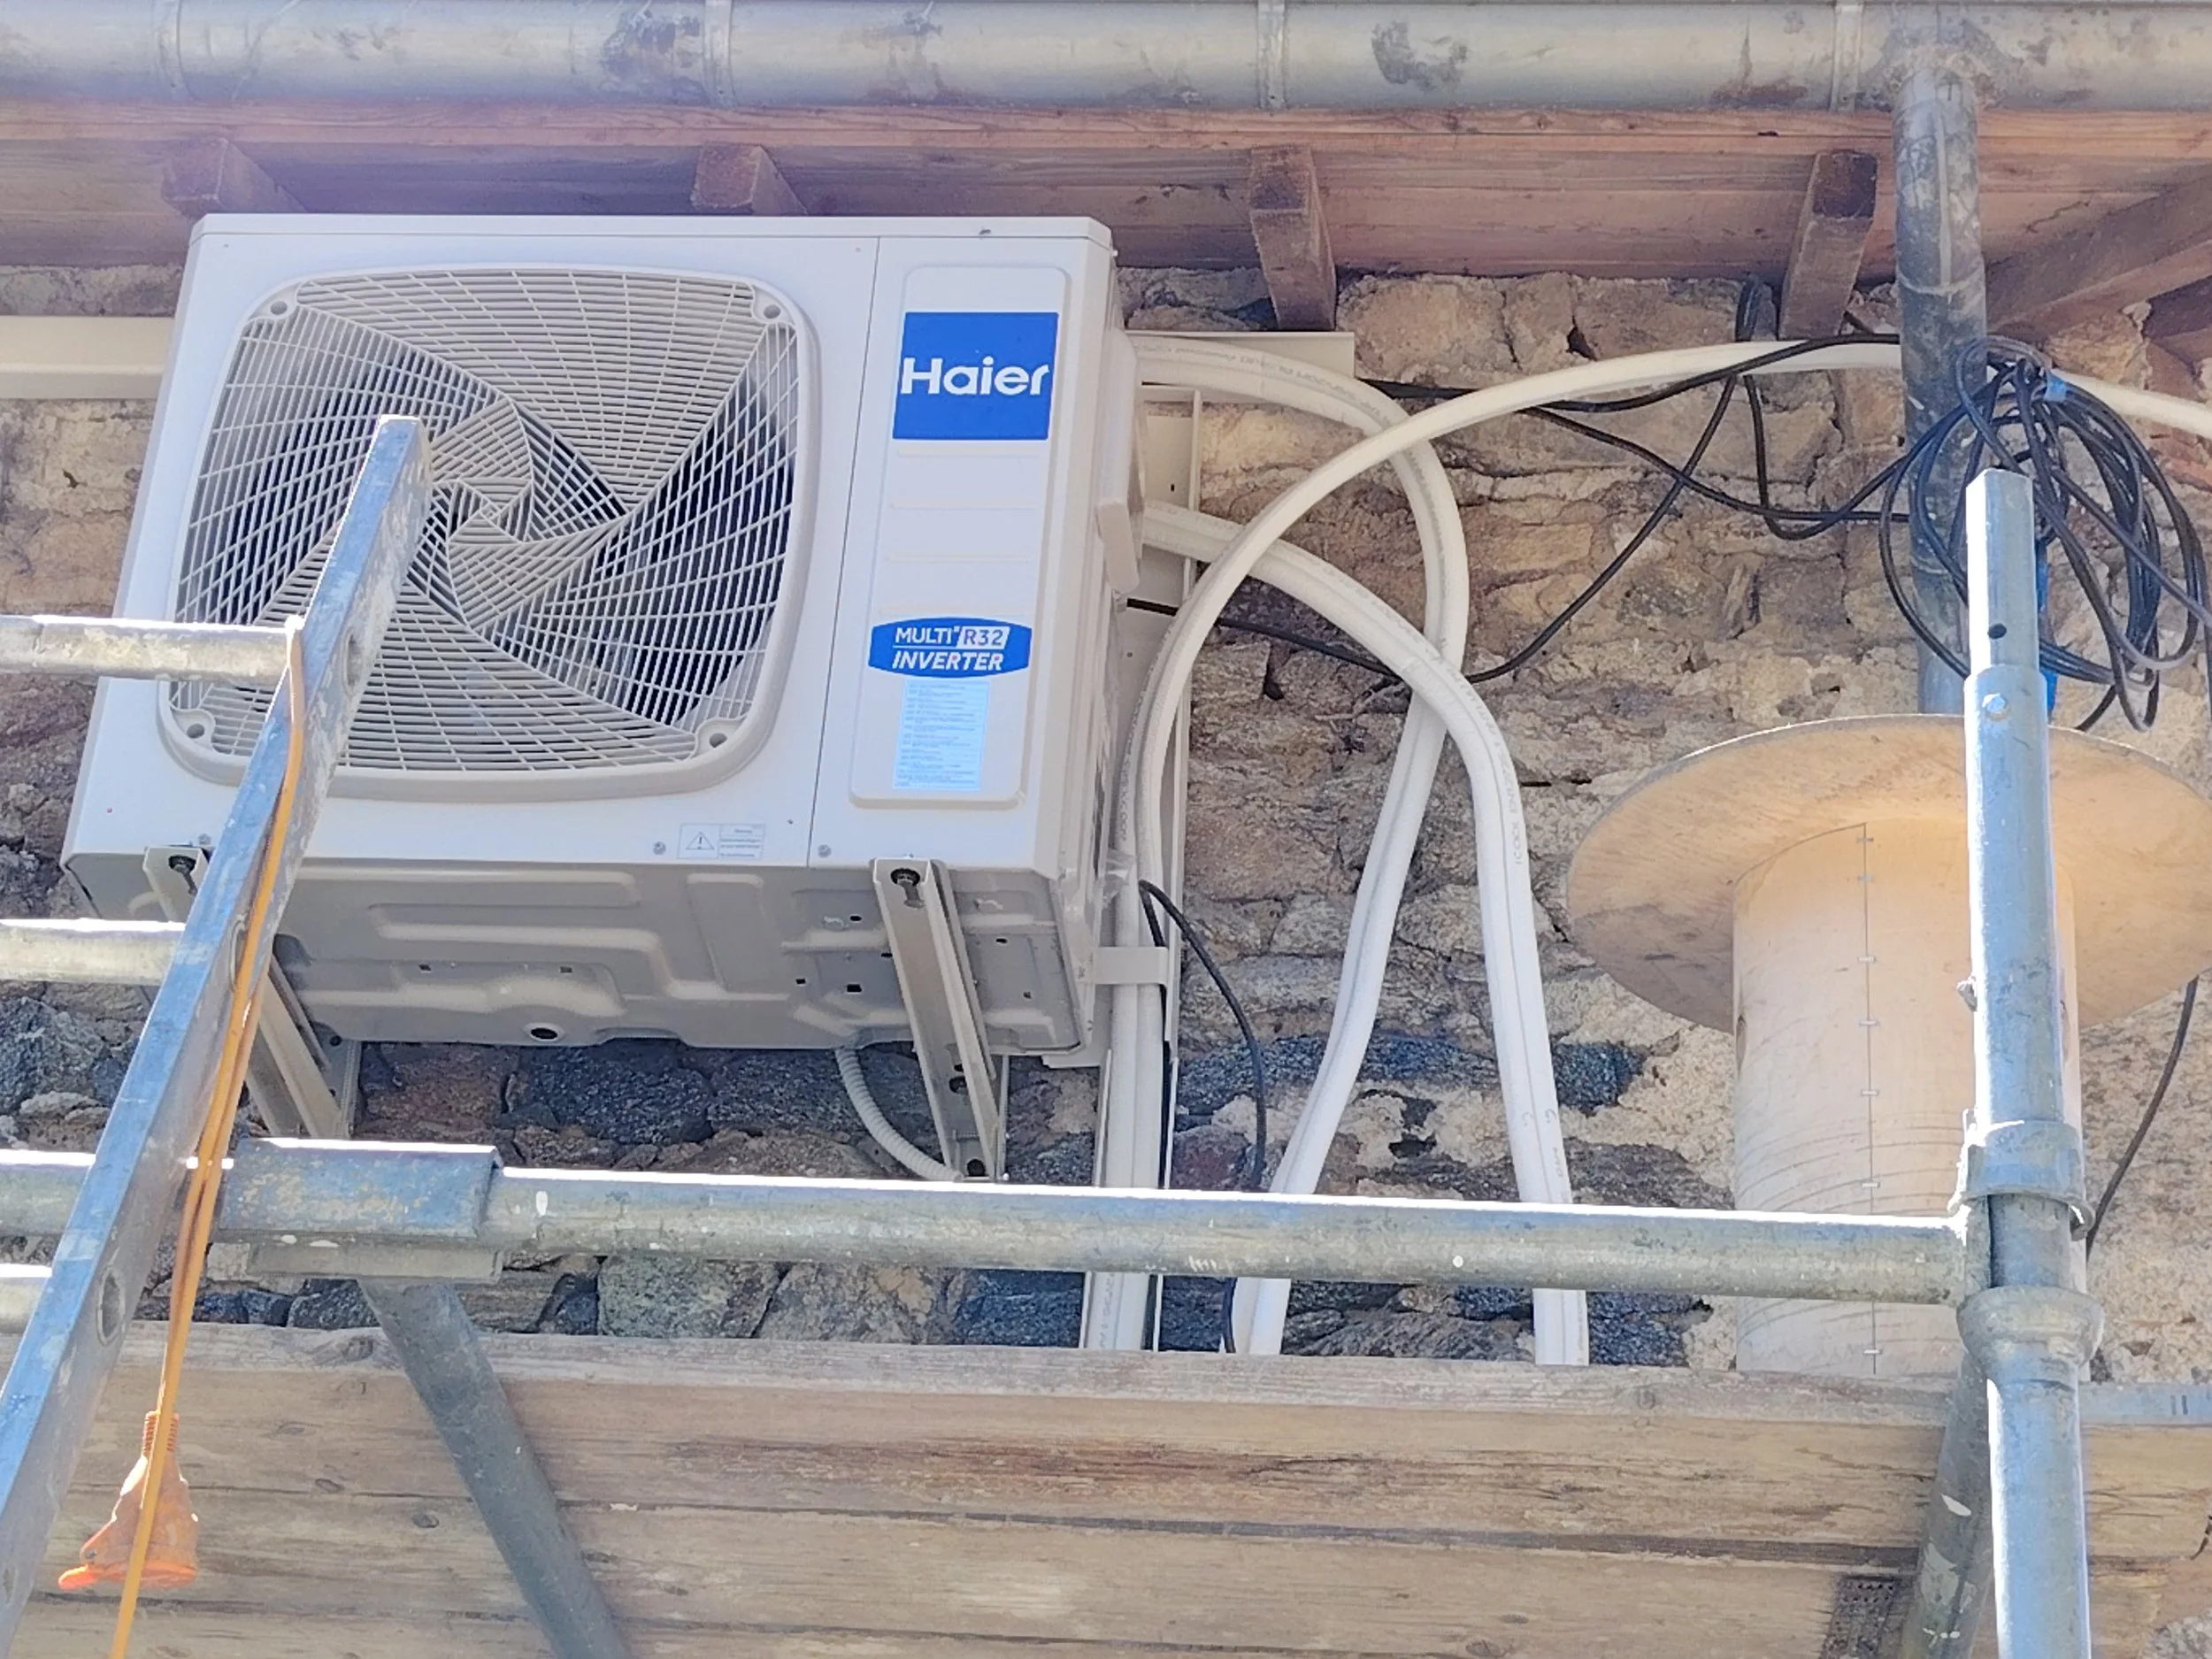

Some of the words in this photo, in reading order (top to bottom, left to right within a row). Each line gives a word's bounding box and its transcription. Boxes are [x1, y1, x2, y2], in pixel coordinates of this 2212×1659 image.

[901, 356, 1050, 395] Haier
[964, 629, 1003, 646] R32
[892, 650, 1004, 671] INVERTER
